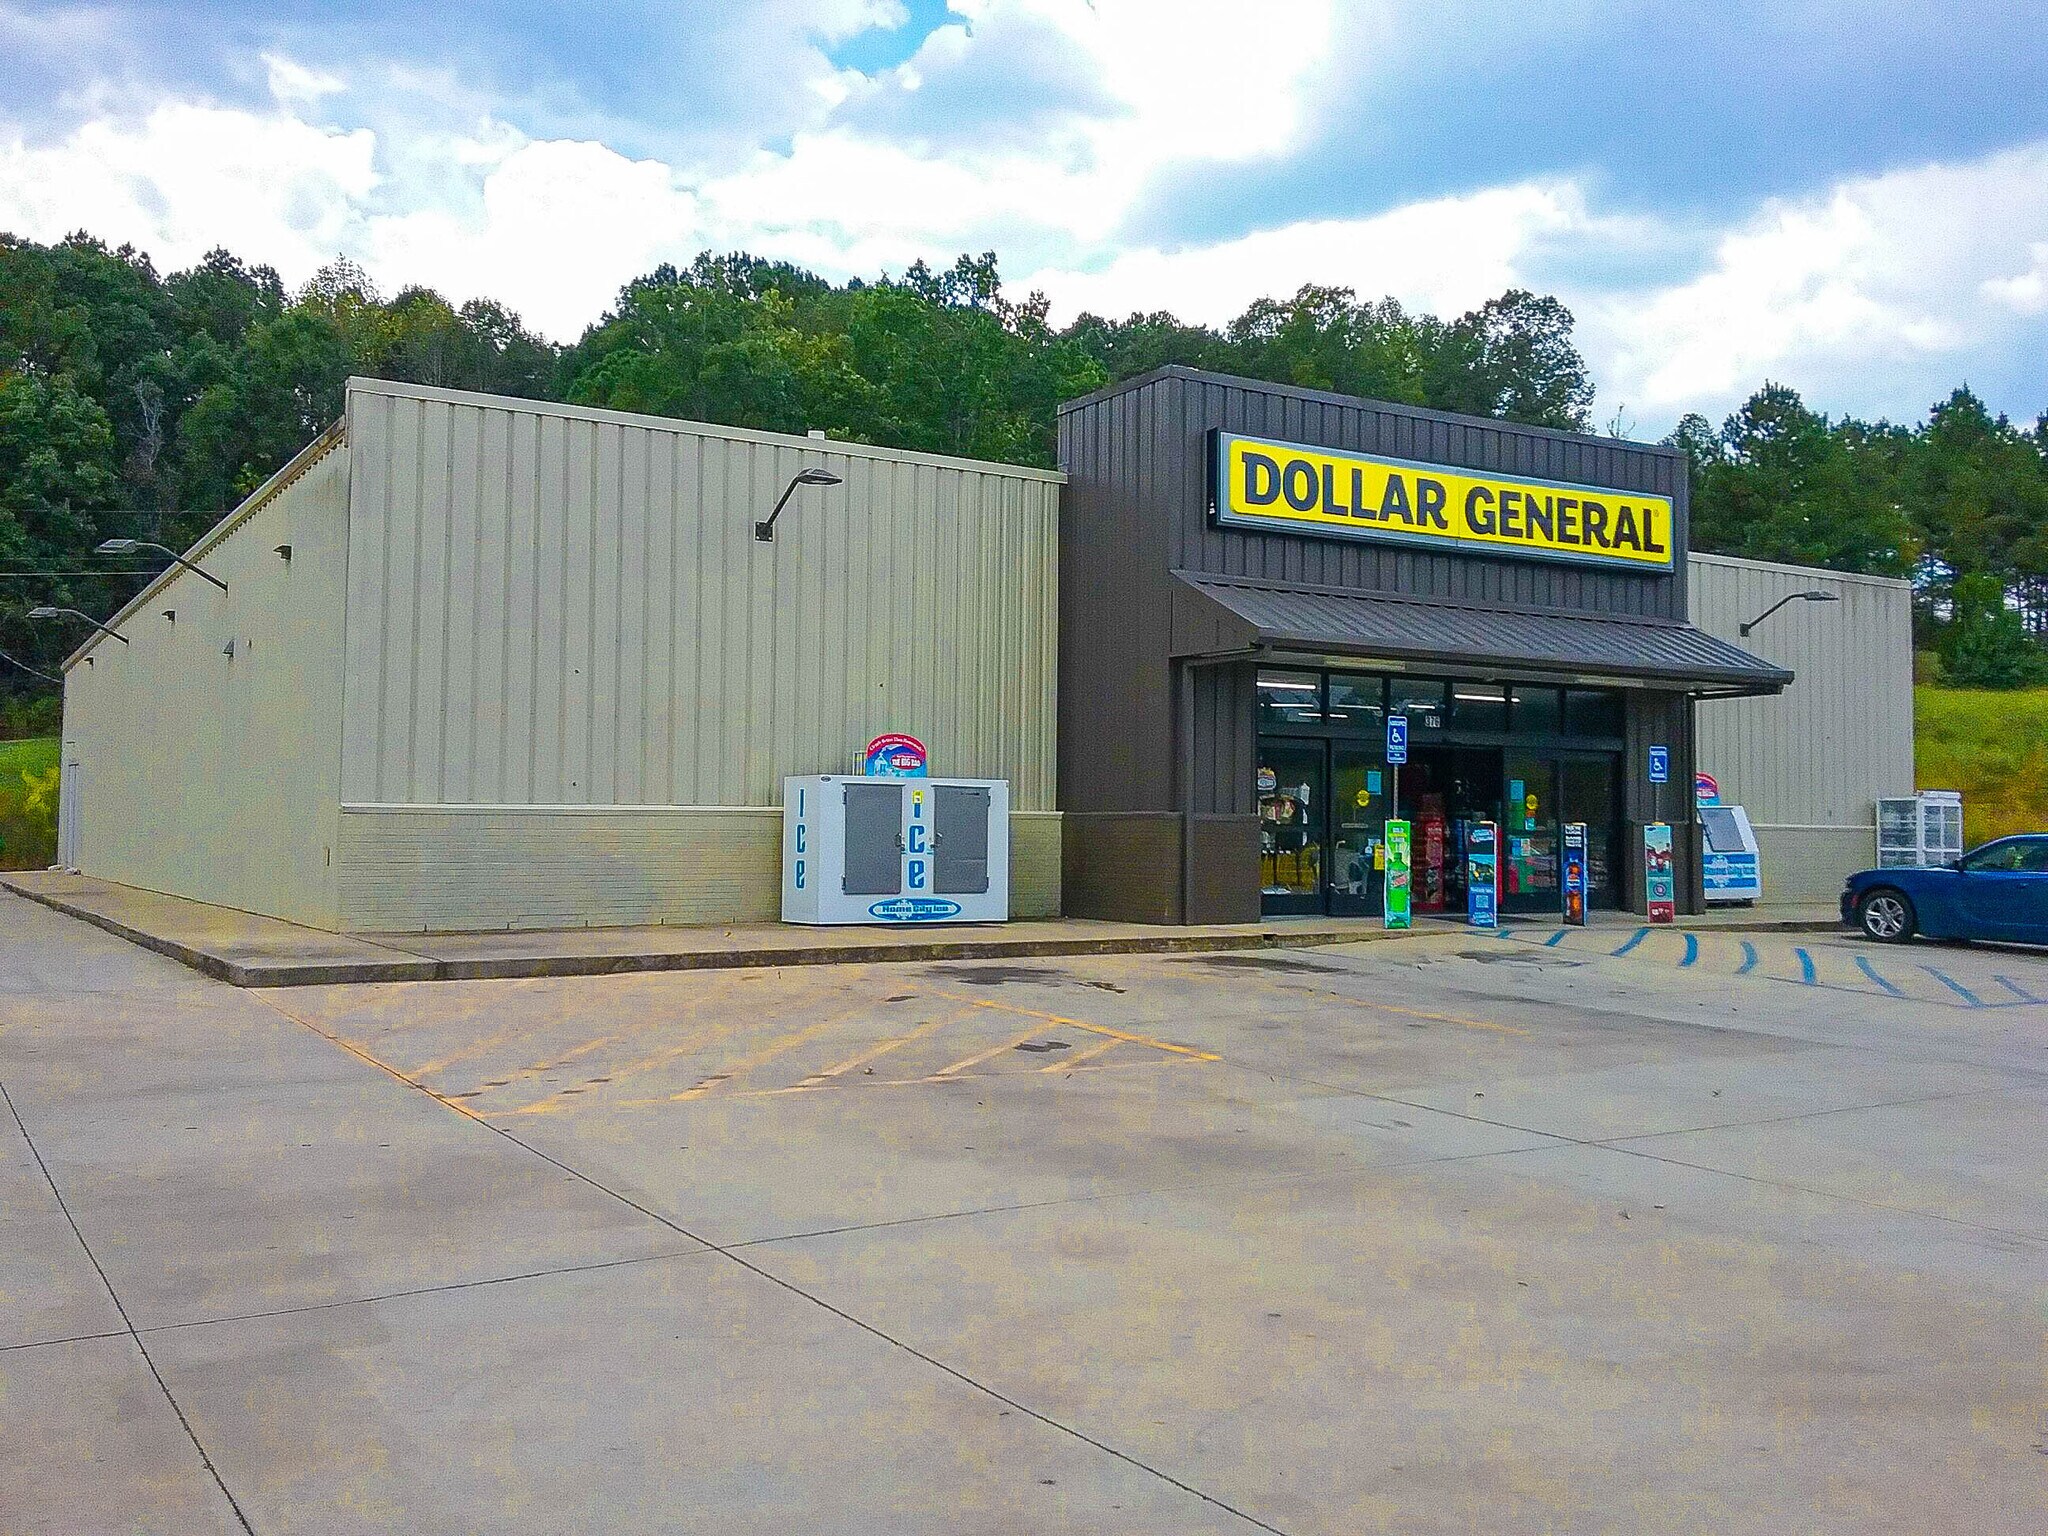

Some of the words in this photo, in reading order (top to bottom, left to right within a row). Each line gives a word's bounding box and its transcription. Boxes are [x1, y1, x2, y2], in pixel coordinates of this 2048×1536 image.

[1242, 451, 1448, 530] DOLLAR
[1465, 486, 1664, 553] GENERAL
[882, 905, 912, 913] Home
[912, 906, 932, 916] City
